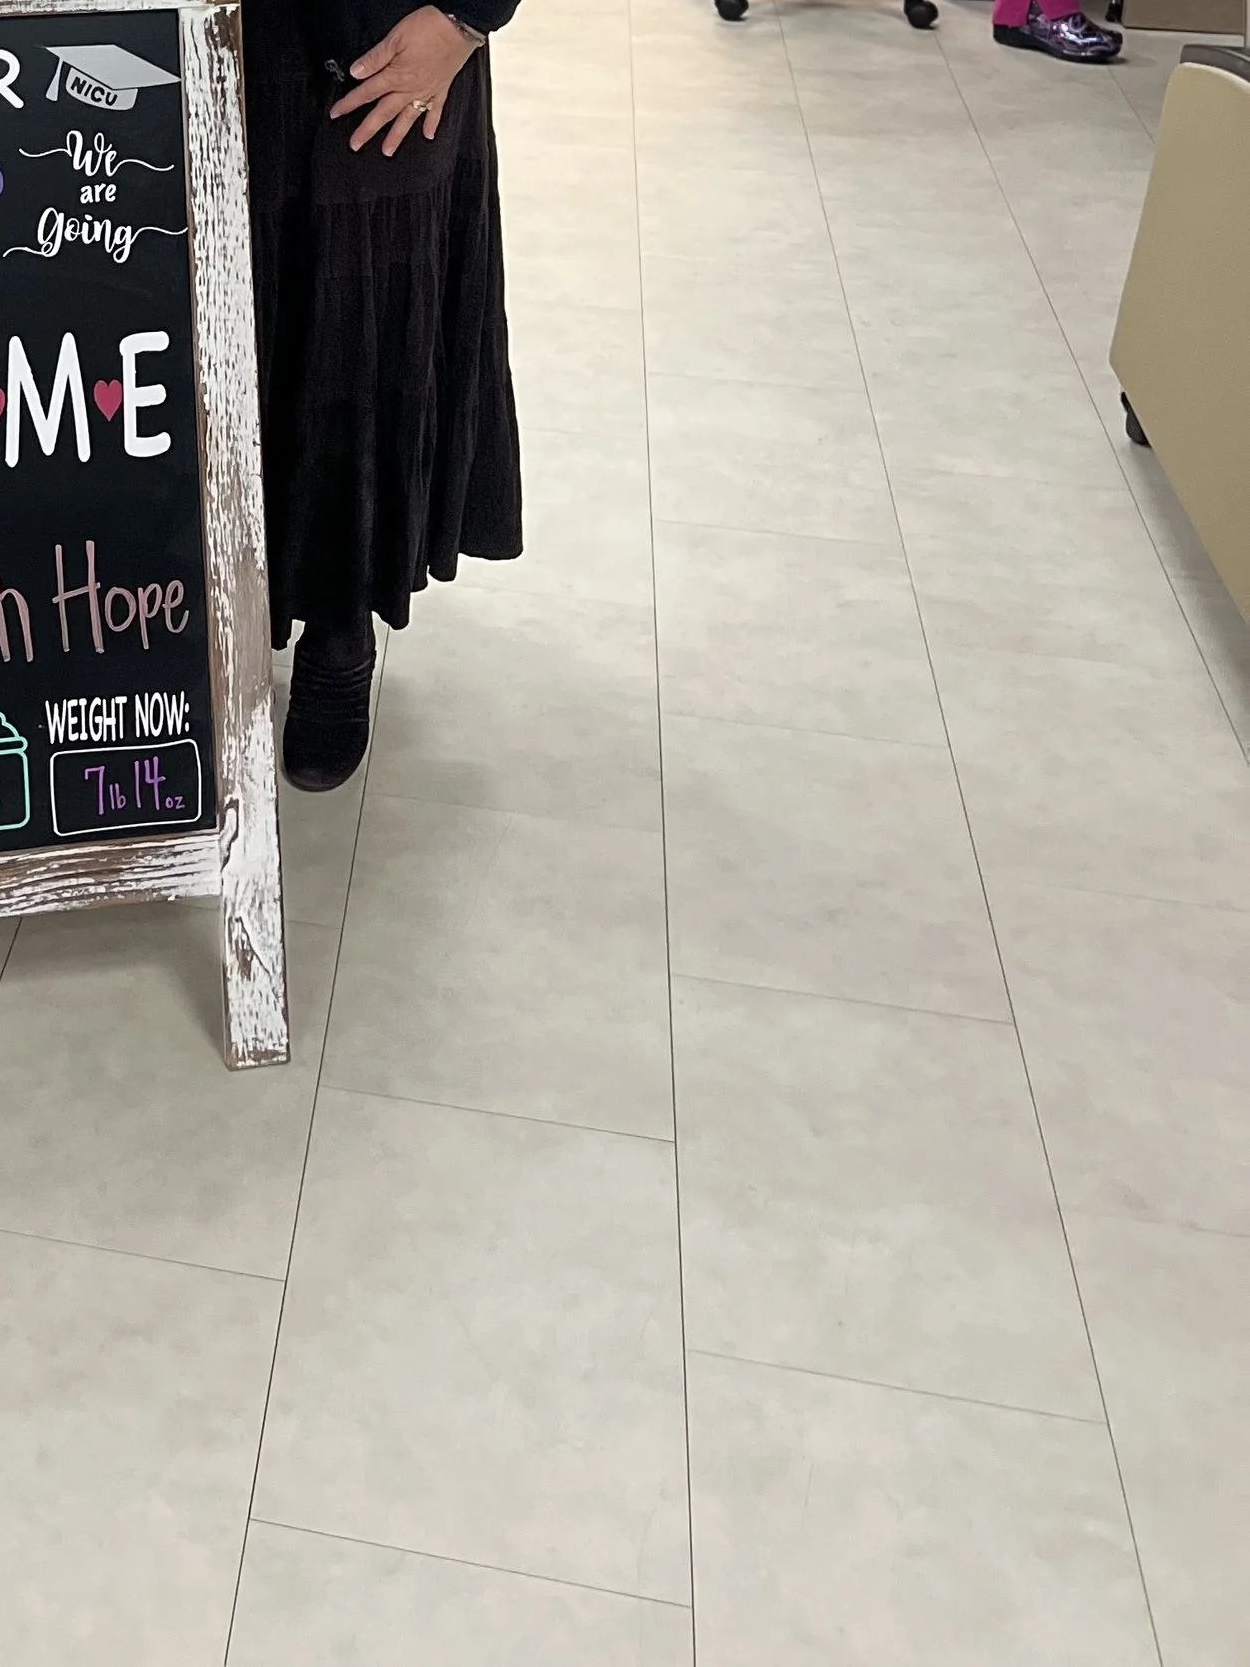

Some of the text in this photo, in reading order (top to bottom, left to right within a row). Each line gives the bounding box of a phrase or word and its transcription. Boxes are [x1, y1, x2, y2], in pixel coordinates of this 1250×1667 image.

[70, 76, 118, 107] NICU
[80, 182, 117, 204] are
[2, 207, 188, 264] Going
[52, 540, 190, 654] Hope
[45, 691, 190, 745] WEIGHT NOW:
